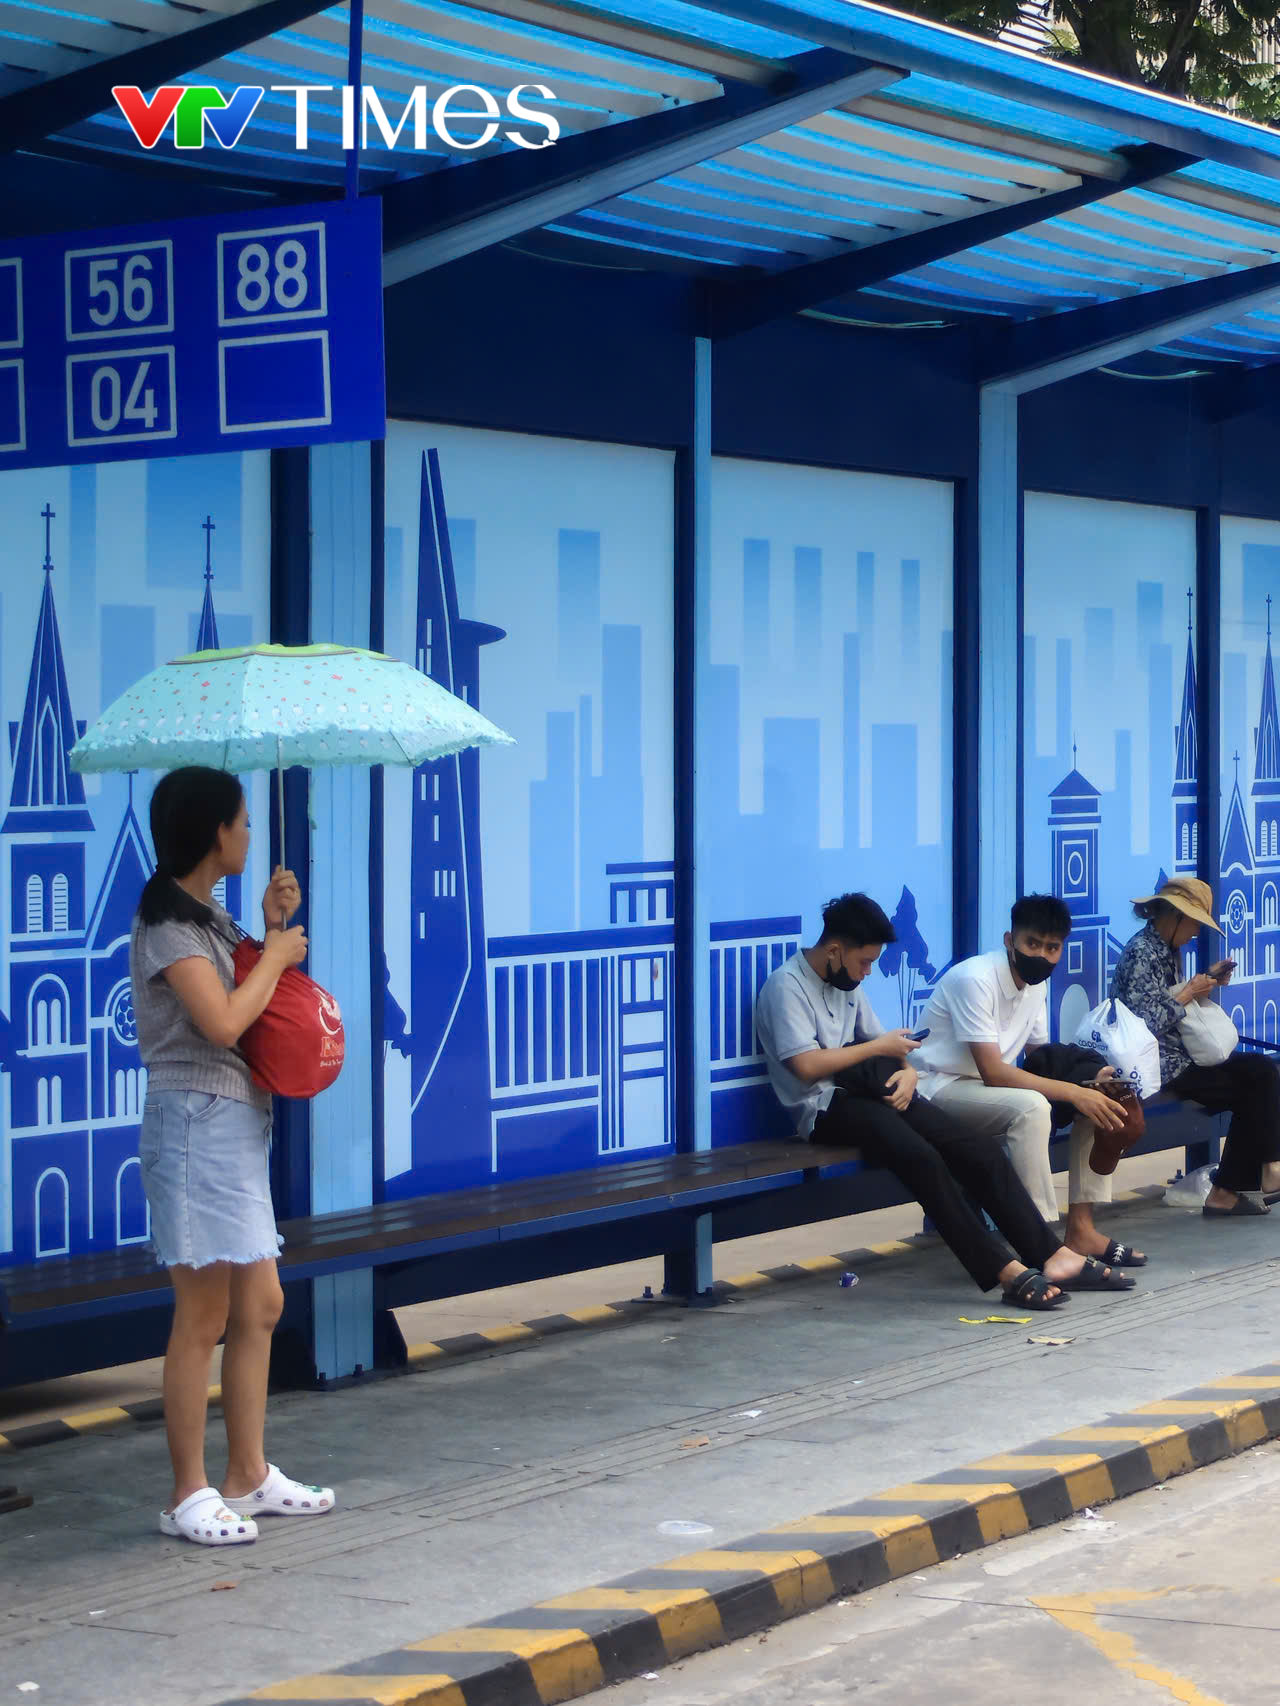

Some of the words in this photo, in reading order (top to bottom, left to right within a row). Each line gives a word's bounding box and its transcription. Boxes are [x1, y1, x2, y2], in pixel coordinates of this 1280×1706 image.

[88, 254, 154, 326] 56
[236, 239, 308, 312] 88
[91, 361, 158, 431] 04
